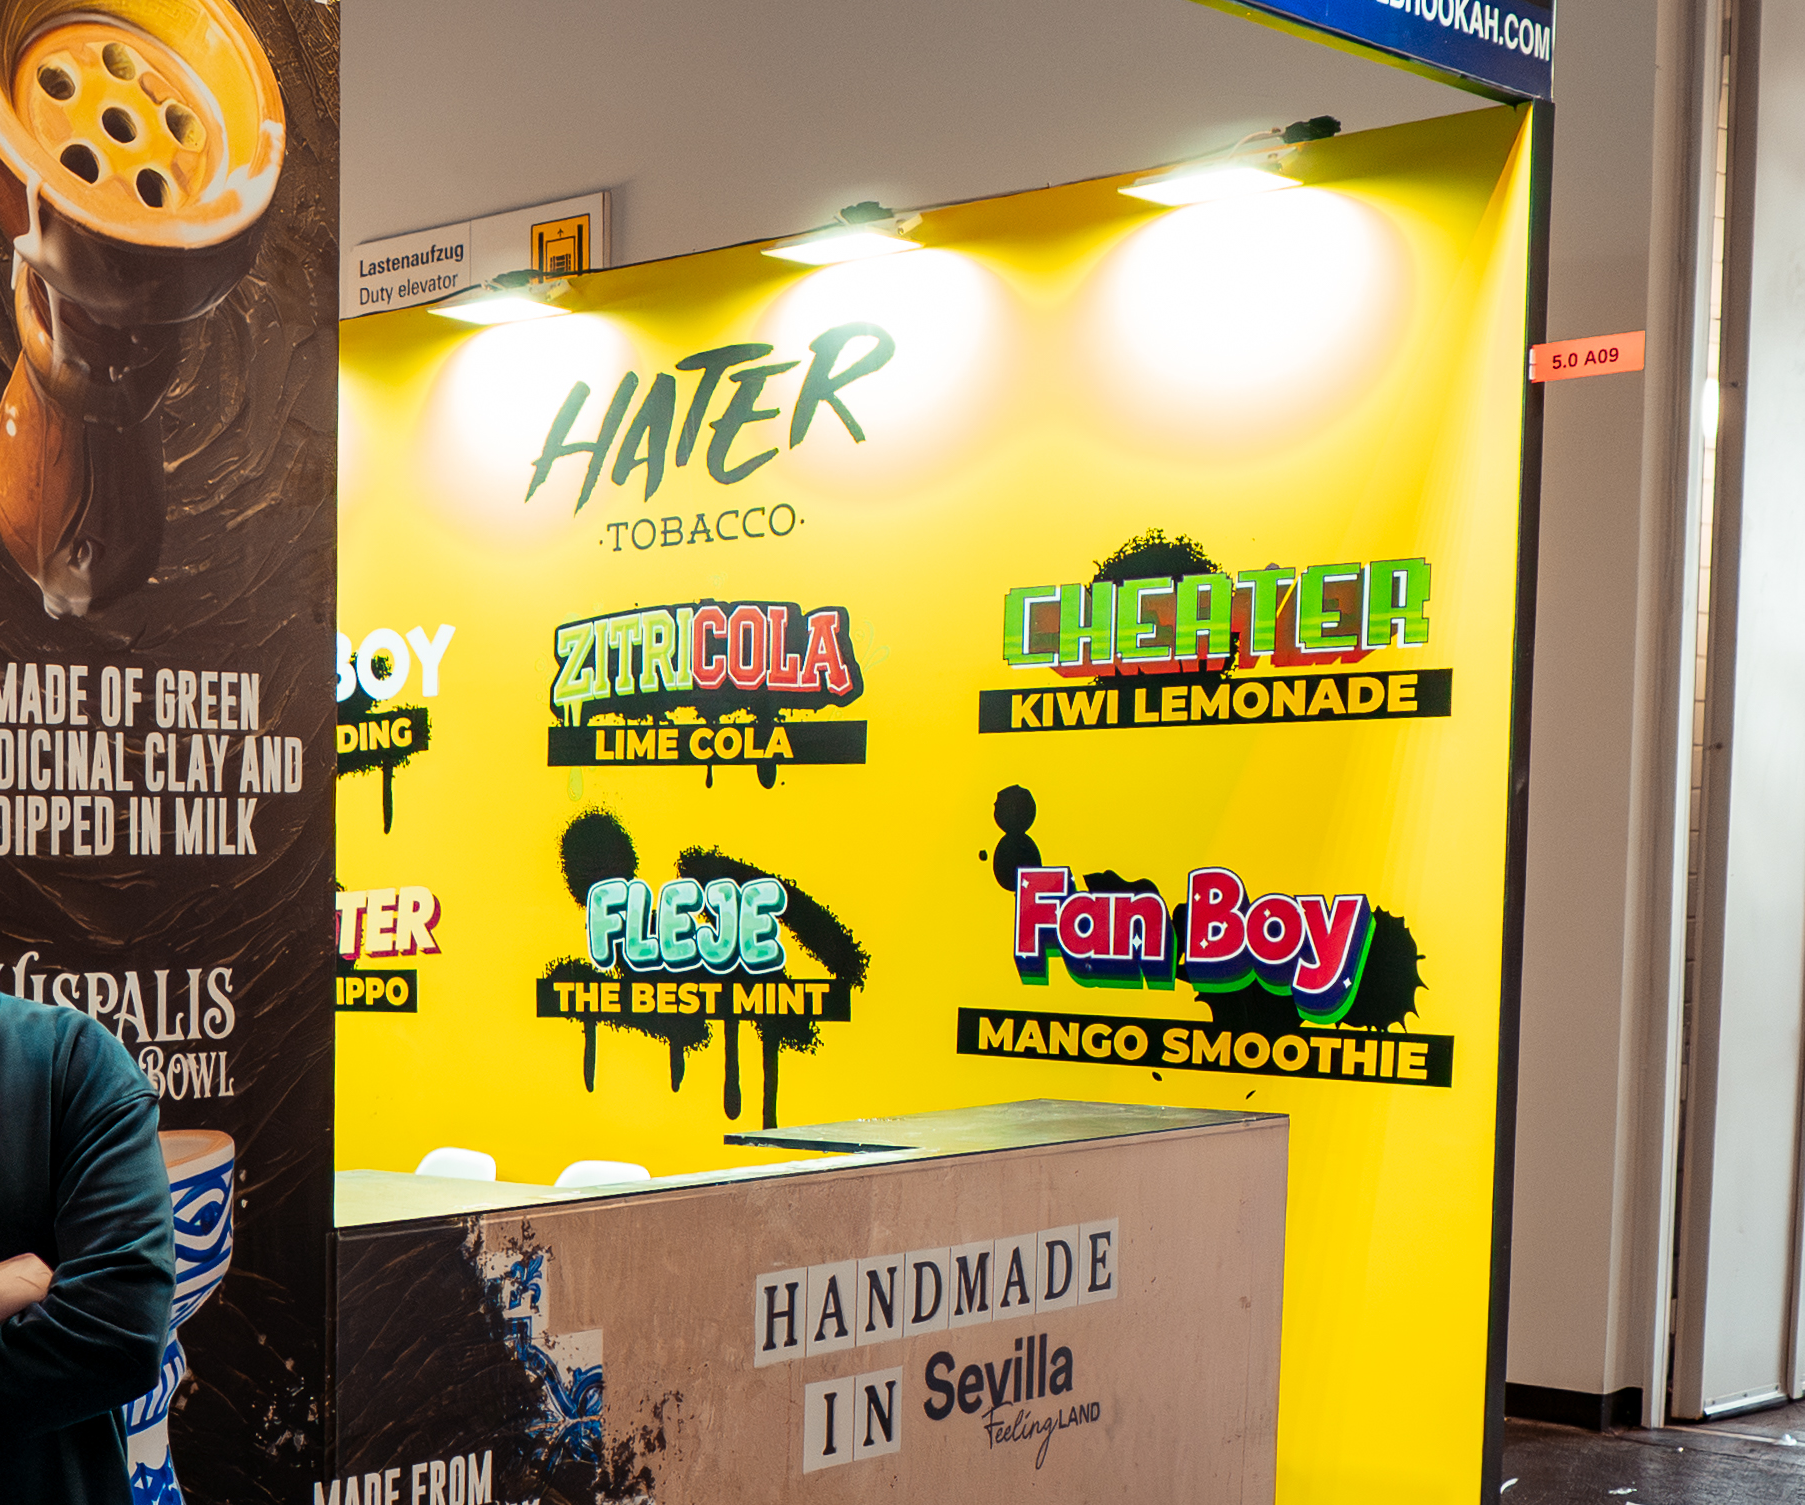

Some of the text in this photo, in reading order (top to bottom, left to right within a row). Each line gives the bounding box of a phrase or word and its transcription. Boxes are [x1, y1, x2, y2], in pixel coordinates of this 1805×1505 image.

[358, 244, 464, 278] Lastenaufzug
[359, 272, 458, 305] Duty elevator
[1551, 347, 1620, 370] 5.0 A09
[524, 322, 895, 514] HATER
[1004, 557, 1432, 670] CHEATER
[100, 665, 143, 728] OF
[155, 668, 260, 731] GREEN
[1010, 674, 1419, 730] KIWI LEMONADE
[145, 732, 231, 793] CLAY
[240, 736, 303, 794] AND
[337, 716, 413, 755] DING
[594, 722, 794, 761] LIME COLA
[129, 797, 161, 856] IN
[175, 797, 257, 856] MILK
[1015, 866, 1373, 1008] Fan Boy
[553, 980, 830, 1016] THE BEST MINT
[139, 1046, 235, 1100] BOWL
[977, 1017, 1430, 1080] MANGO SMOOTHIE
[762, 1230, 1112, 1352] HANDMADE
[822, 1333, 1074, 1456] IN Sevilla
